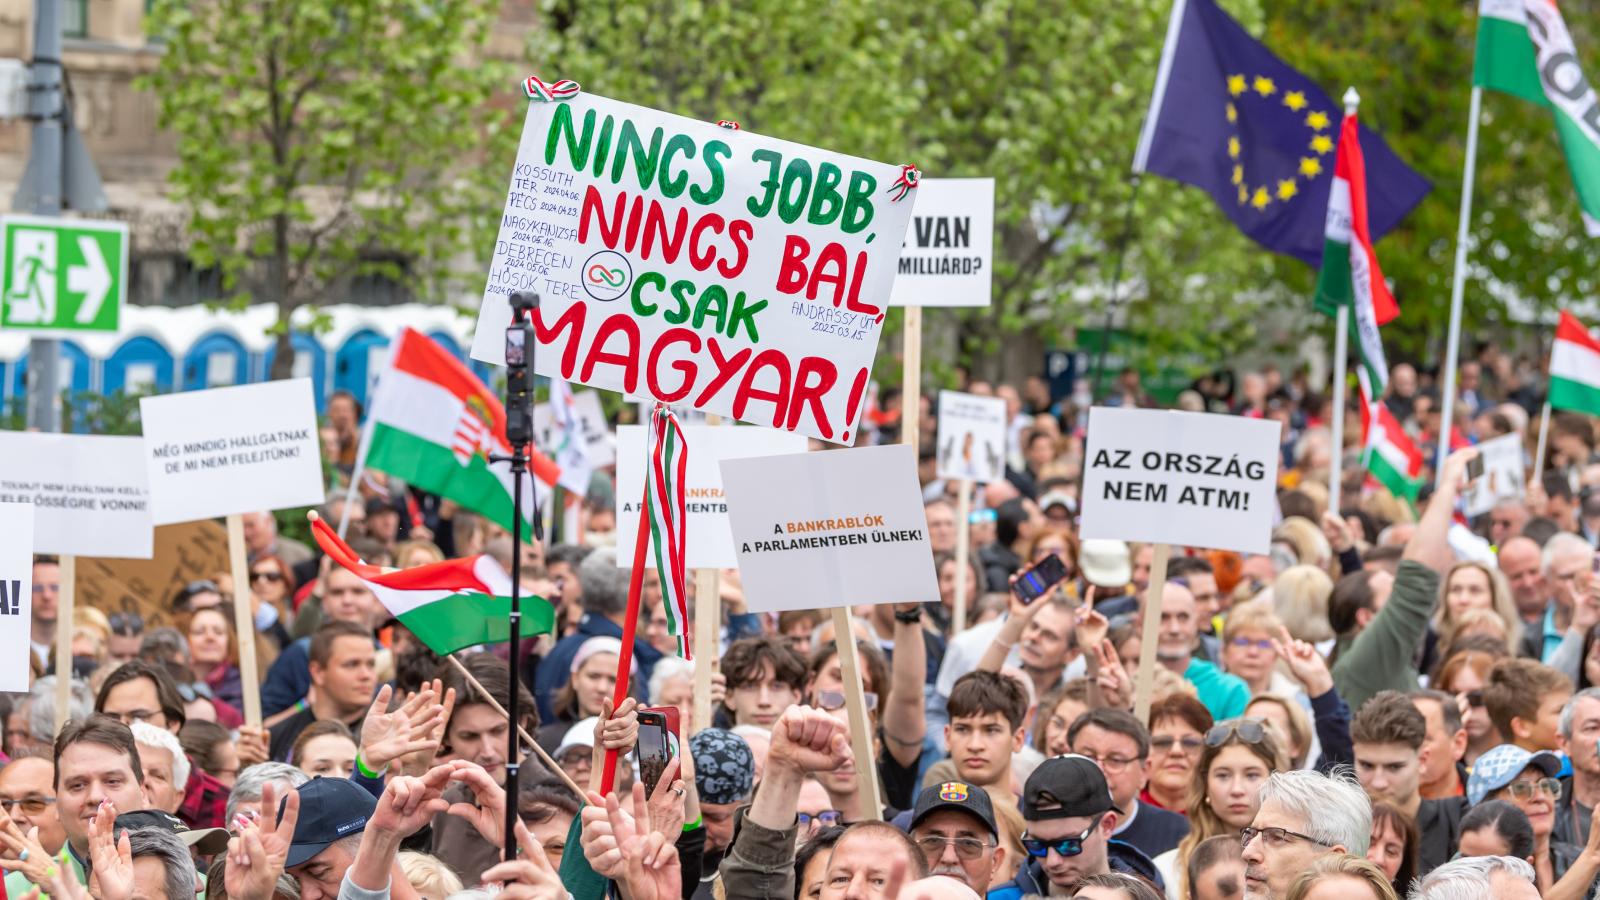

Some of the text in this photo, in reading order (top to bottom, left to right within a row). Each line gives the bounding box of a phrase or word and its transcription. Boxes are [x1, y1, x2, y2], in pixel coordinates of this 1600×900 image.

[515, 163, 574, 187] KOSSUTH
[515, 178, 538, 193] TÉR
[545, 103, 877, 244] NINCS JOBB,
[509, 191, 537, 211] PÉCS
[503, 214, 578, 242] NAGYKANIZSA
[914, 216, 970, 248] VAN
[496, 240, 573, 269] DEBRECEN
[578, 184, 884, 324] NINCS BAL,
[898, 254, 982, 275] MILLIÁRD?
[544, 278, 582, 300] TERE
[631, 271, 769, 343] CSAK
[791, 301, 856, 325] ANDRÁSSY
[512, 300, 868, 441] MAGYAR!
[153, 428, 310, 458] MÉG MINDIG HALLGATNAK
[165, 446, 300, 474] DE MI NEM FELEJTÜNK!
[1092, 449, 1265, 481] AZ ORSZÁG
[623, 503, 632, 512] A
[1103, 481, 1250, 511] NEM ATM!
[774, 514, 885, 534] A BANKRABLÓK
[742, 530, 923, 553] A PARLAMENTBEN ÜLNEK!
